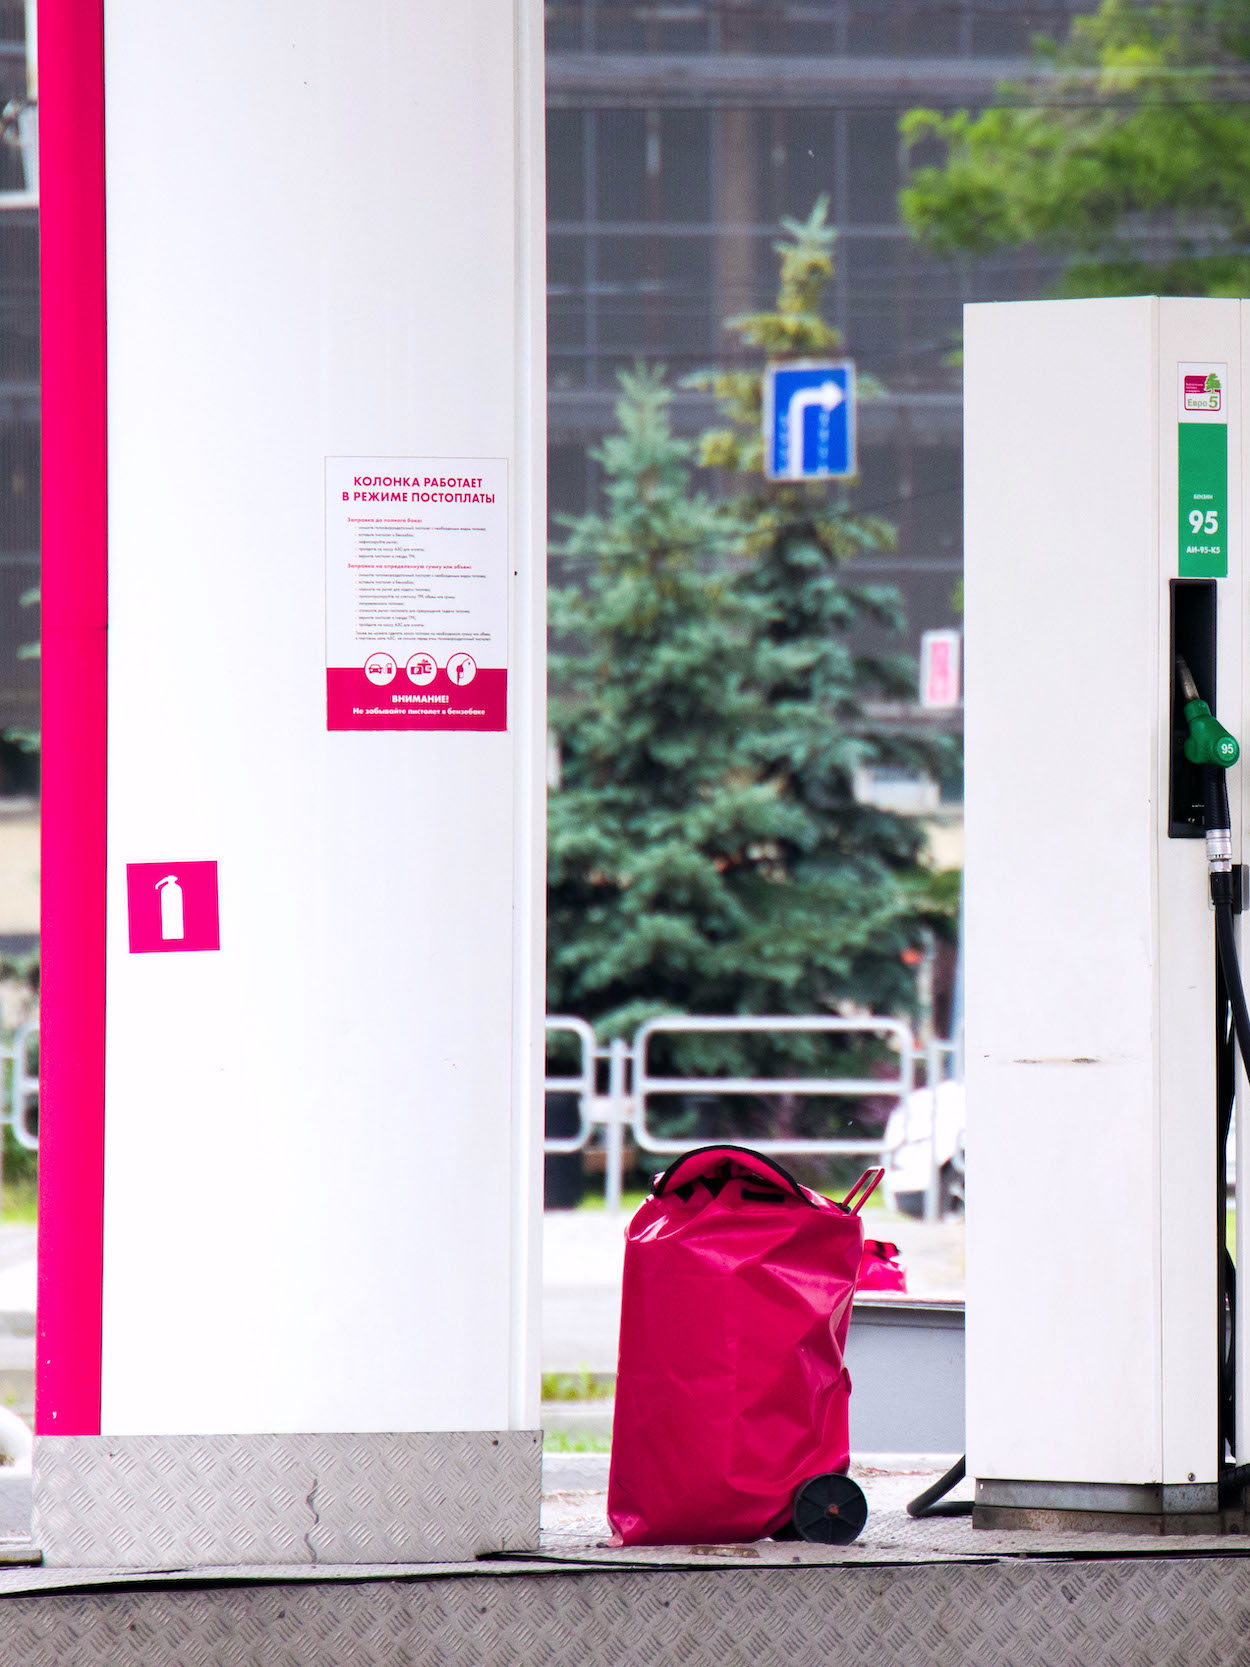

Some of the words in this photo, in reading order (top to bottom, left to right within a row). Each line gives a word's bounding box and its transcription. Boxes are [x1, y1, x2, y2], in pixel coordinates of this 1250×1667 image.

[1187, 399, 1208, 408] Евро
[1209, 395, 1218, 408] 5
[354, 476, 420, 487] КОЛОНКА
[424, 477, 483, 488] РАБОТАЕТ
[342, 491, 350, 501] В
[353, 492, 408, 502] РЕЖИМЕ
[411, 493, 495, 503] ПОСТОПЛАТЫ
[1188, 509, 1219, 535] 95
[1186, 545, 1221, 554] АИ-95-К5
[391, 695, 449, 703] ВНИМАНИЕ!
[352, 707, 364, 715] Не
[365, 707, 406, 715] забывайте
[447, 707, 485, 715] бензобаке
[1221, 743, 1234, 755] 95
